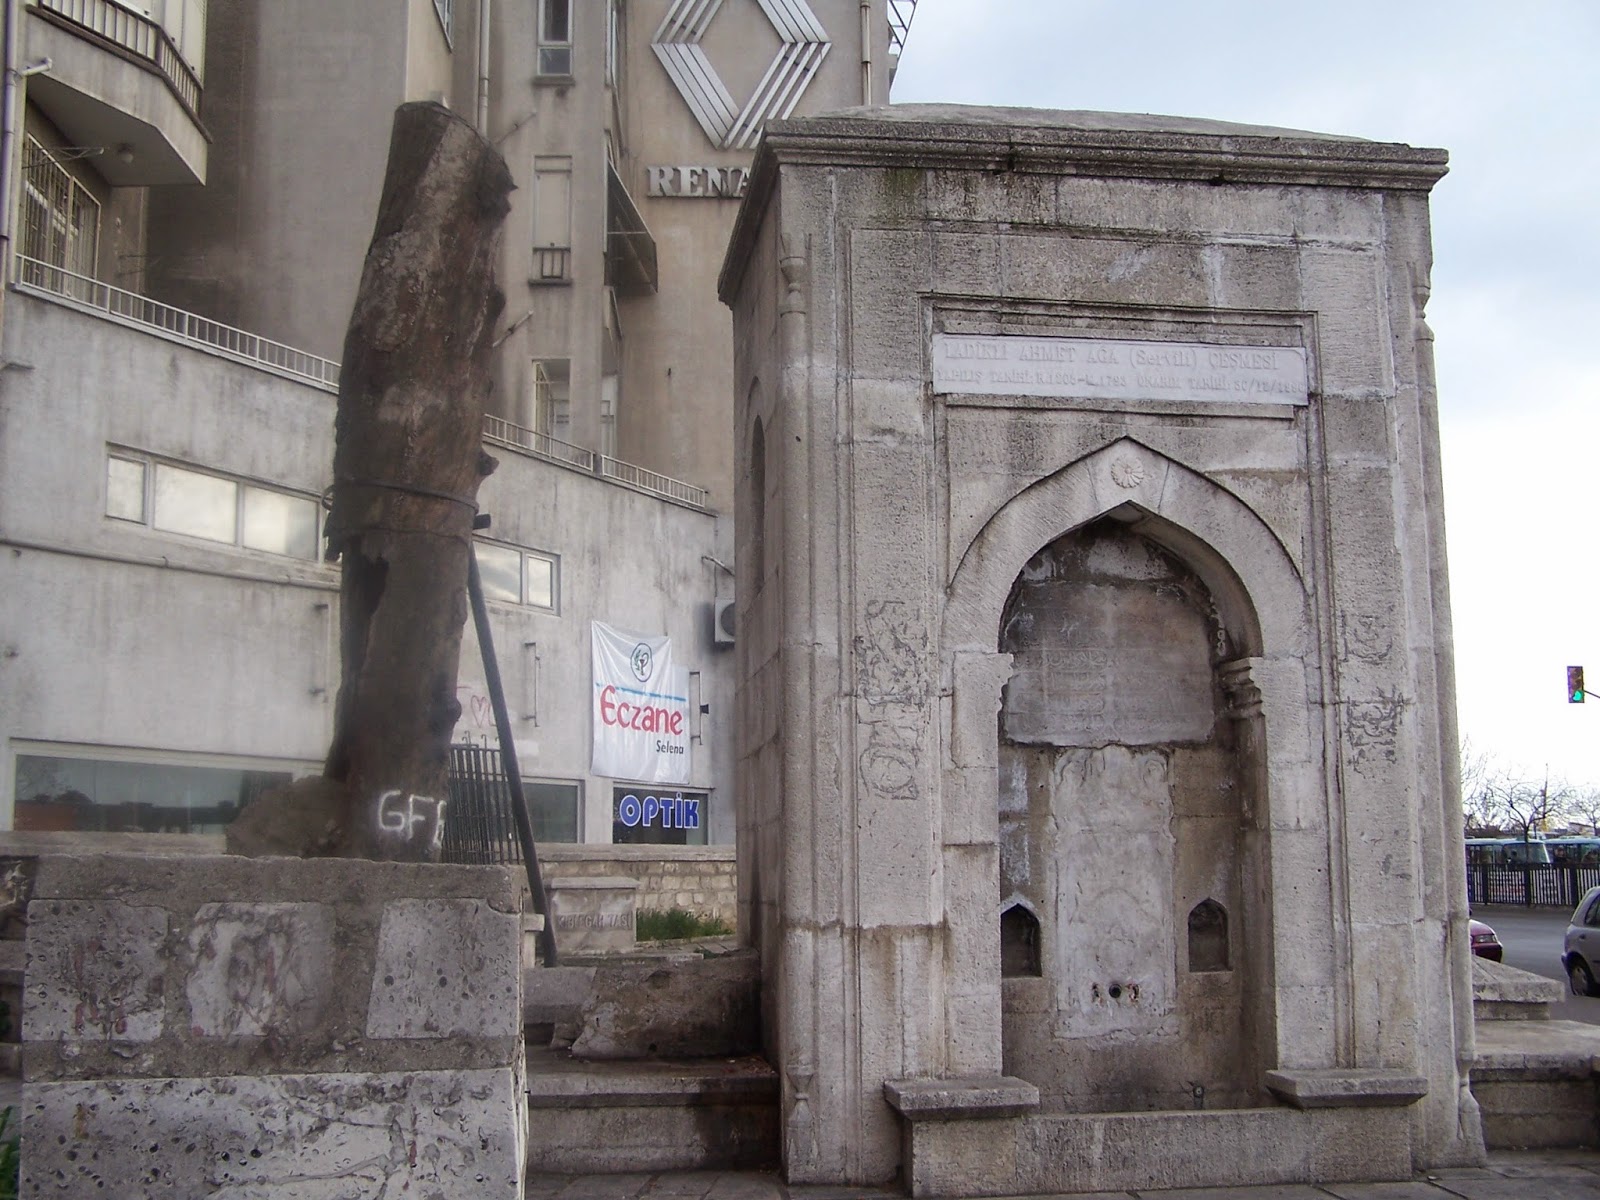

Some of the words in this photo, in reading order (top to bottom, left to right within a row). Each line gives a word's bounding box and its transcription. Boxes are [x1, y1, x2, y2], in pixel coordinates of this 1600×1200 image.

[647, 165, 750, 198] RENA
[1019, 344, 1075, 362] AHMET
[600, 684, 683, 736] Eczane
[656, 739, 684, 755] Selena
[619, 791, 700, 829] OPTİK
